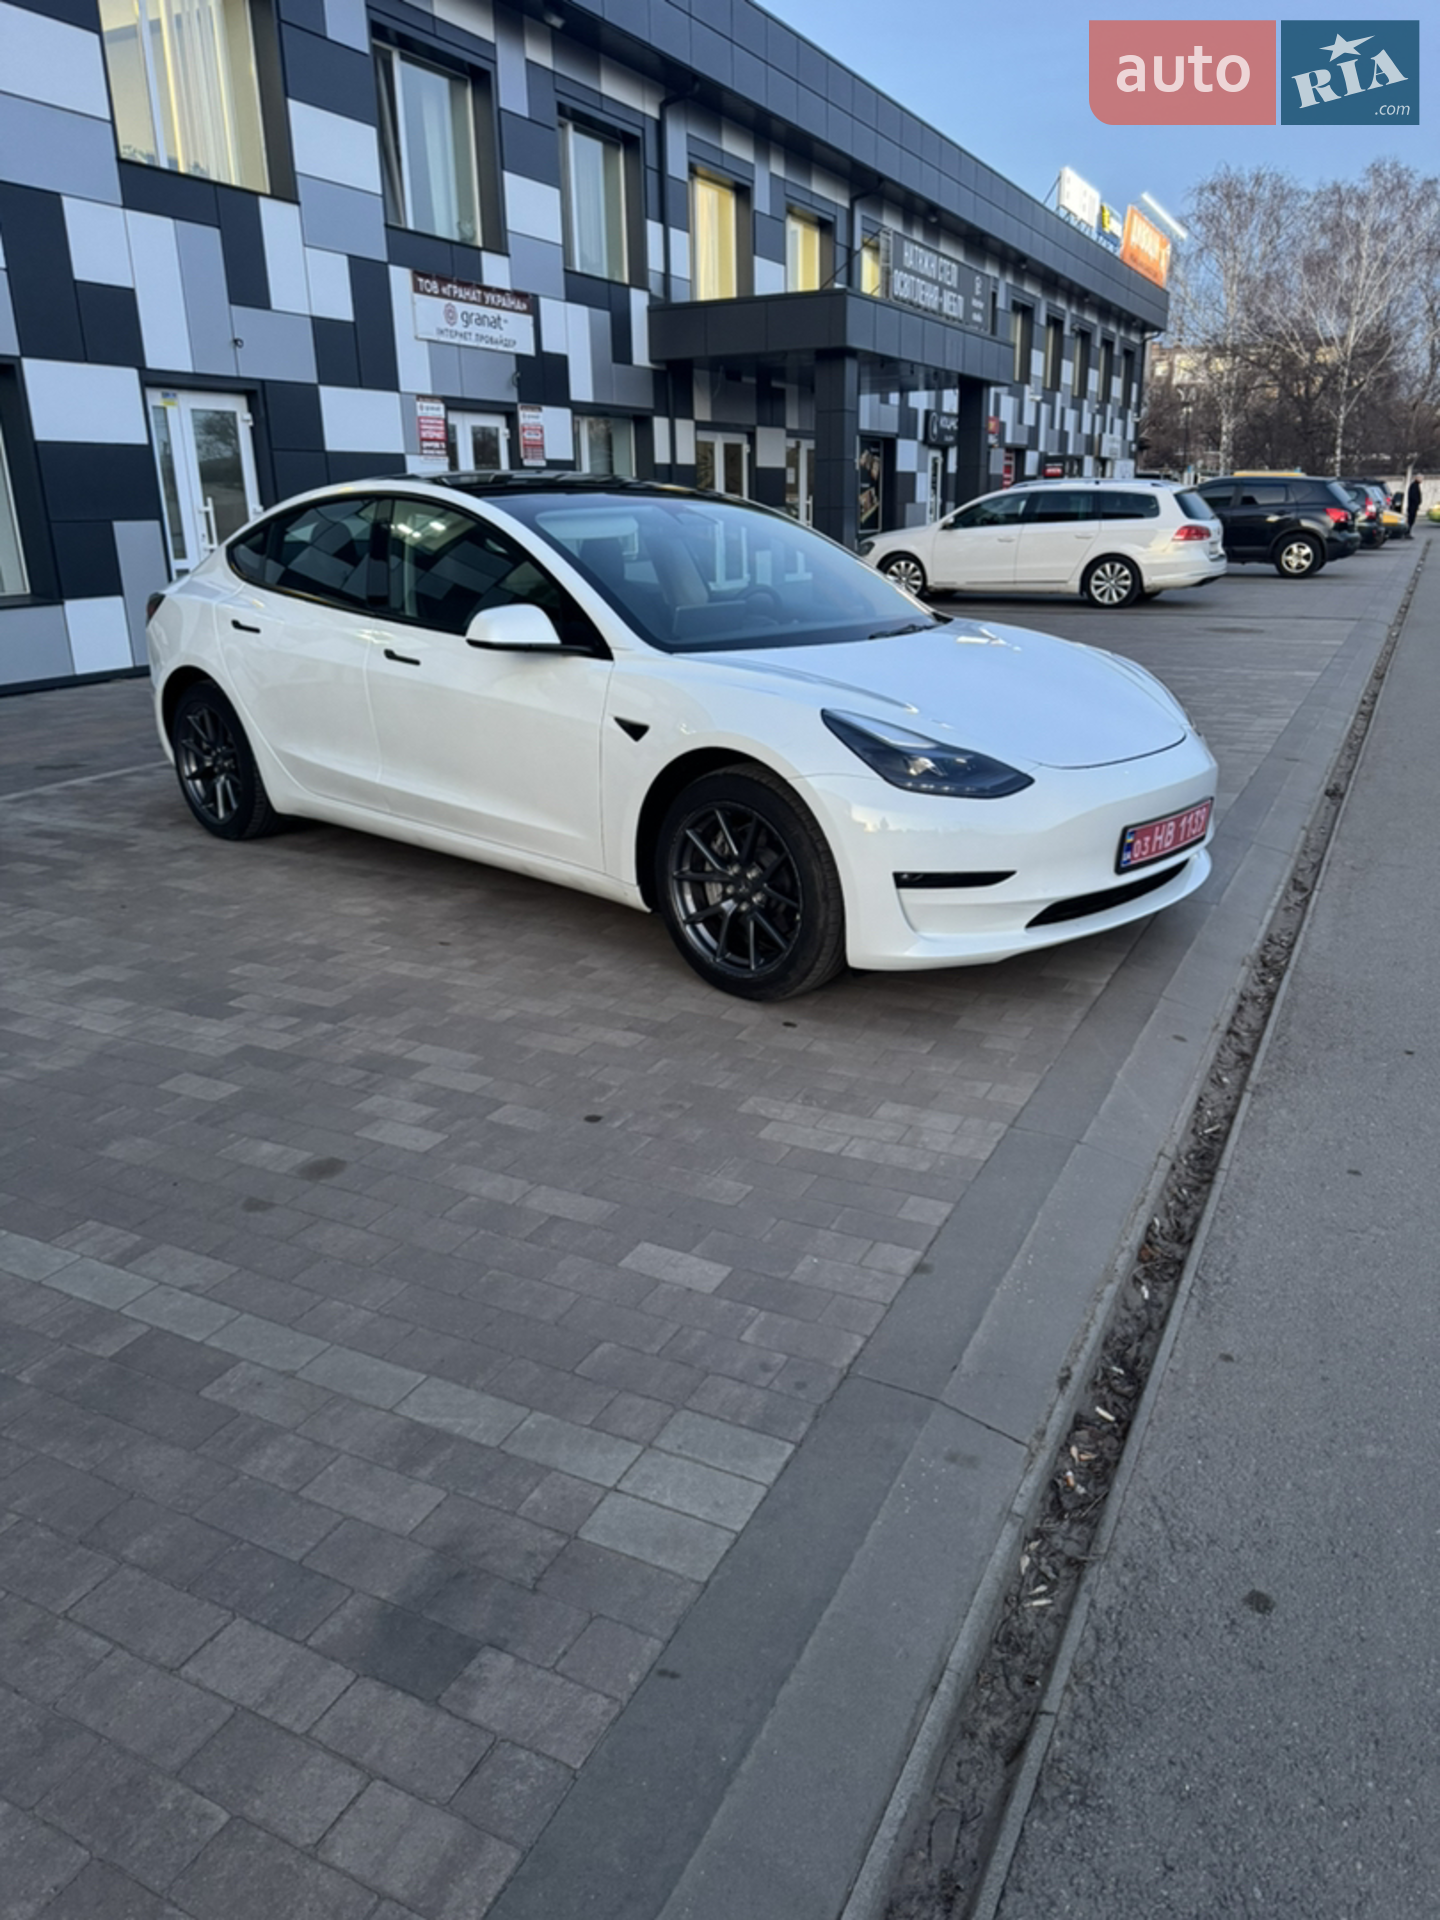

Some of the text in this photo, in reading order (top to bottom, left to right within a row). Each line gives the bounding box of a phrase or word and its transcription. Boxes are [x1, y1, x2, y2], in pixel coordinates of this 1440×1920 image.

[417, 277, 440, 294] ТОВ
[441, 283, 483, 303] «ГРАНАТ
[460, 310, 504, 331] granat
[436, 327, 517, 348] ІНТЕРНЕТ ПРОВАЙДЕР
